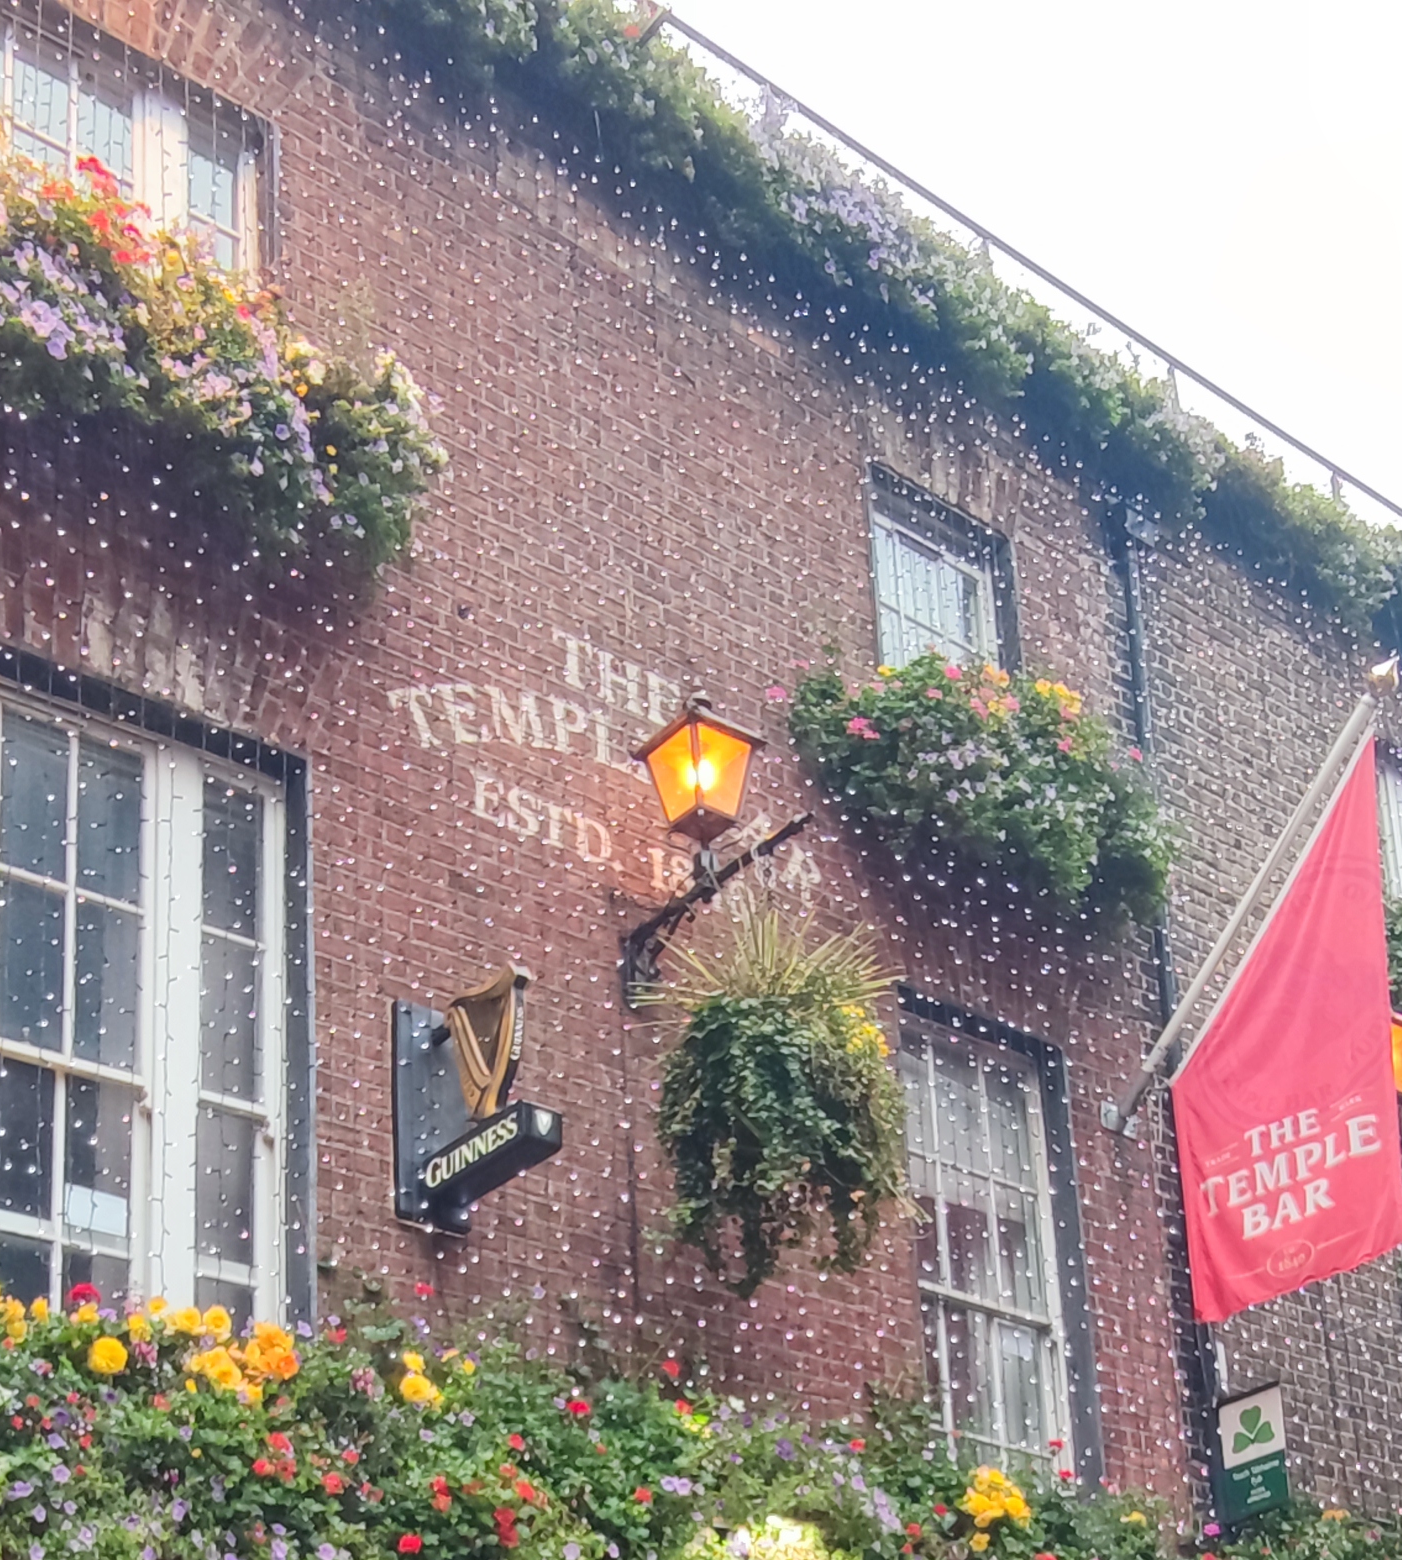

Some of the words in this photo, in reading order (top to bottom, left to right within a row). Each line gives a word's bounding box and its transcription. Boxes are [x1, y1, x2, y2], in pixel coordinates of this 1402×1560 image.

[553, 629, 681, 724] THE
[387, 684, 651, 785] TEMPL
[425, 1112, 519, 1189] GUINNESS
[1202, 1113, 1382, 1217] TEMPLE
[1244, 1108, 1320, 1158] THE
[1242, 1179, 1335, 1240] BAR
